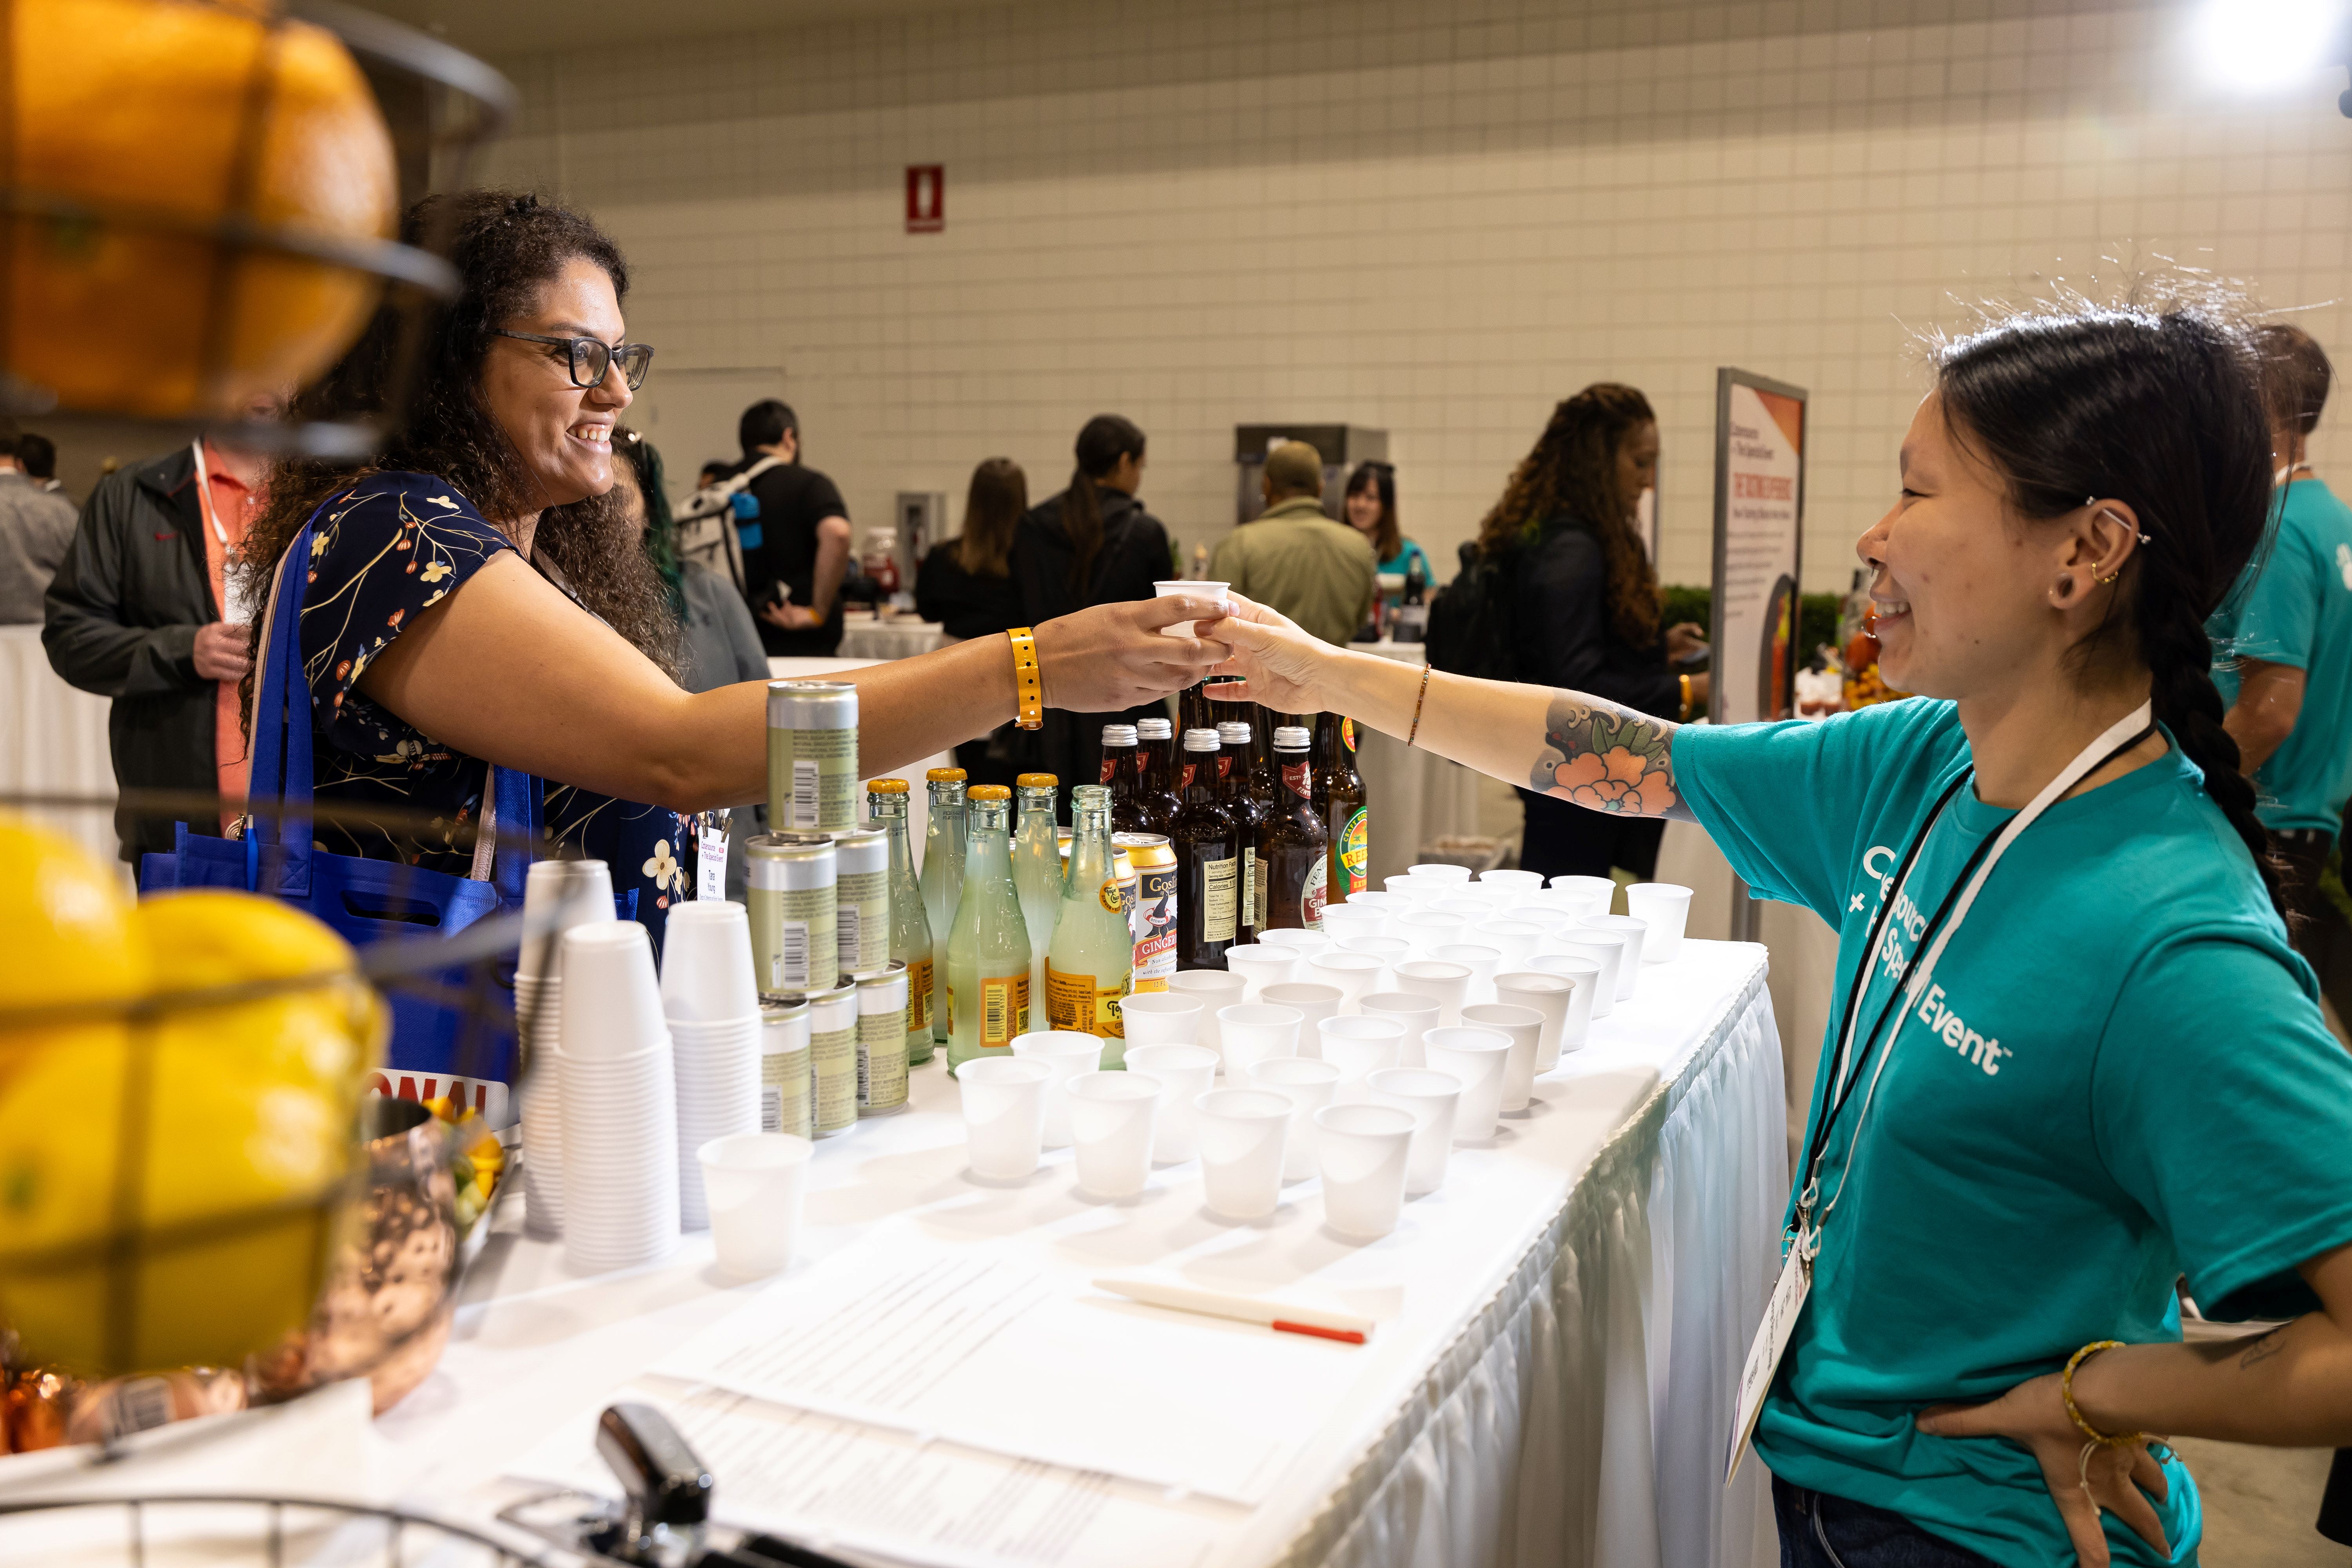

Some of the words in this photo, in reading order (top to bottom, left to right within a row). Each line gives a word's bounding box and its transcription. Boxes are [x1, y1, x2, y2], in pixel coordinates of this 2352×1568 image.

[1343, 820, 1357, 842] CRAFT
[708, 853, 717, 862] Special
[1918, 984, 2002, 1076] Event
